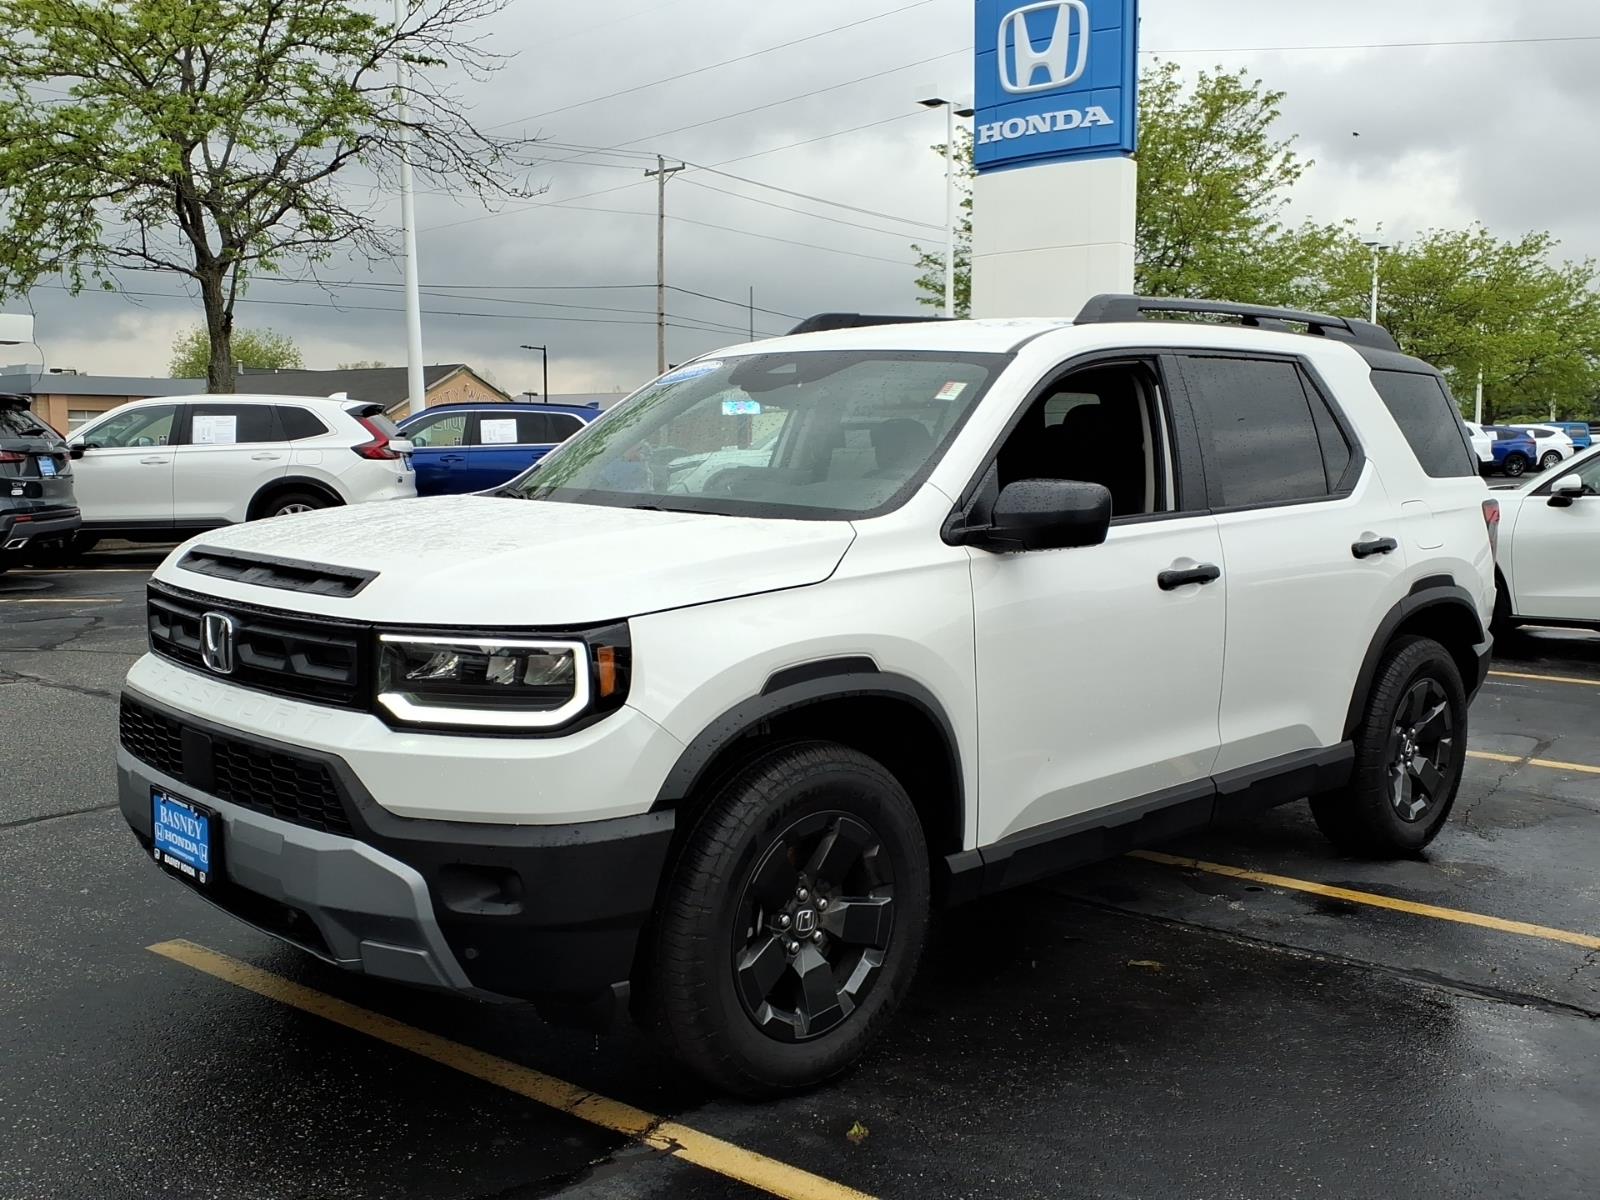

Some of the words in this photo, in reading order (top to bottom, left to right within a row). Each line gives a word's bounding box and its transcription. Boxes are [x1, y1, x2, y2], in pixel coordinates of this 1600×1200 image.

[977, 106, 1114, 144] HONDA
[160, 805, 202, 839] BASNEY
[164, 829, 199, 855] HONDA
